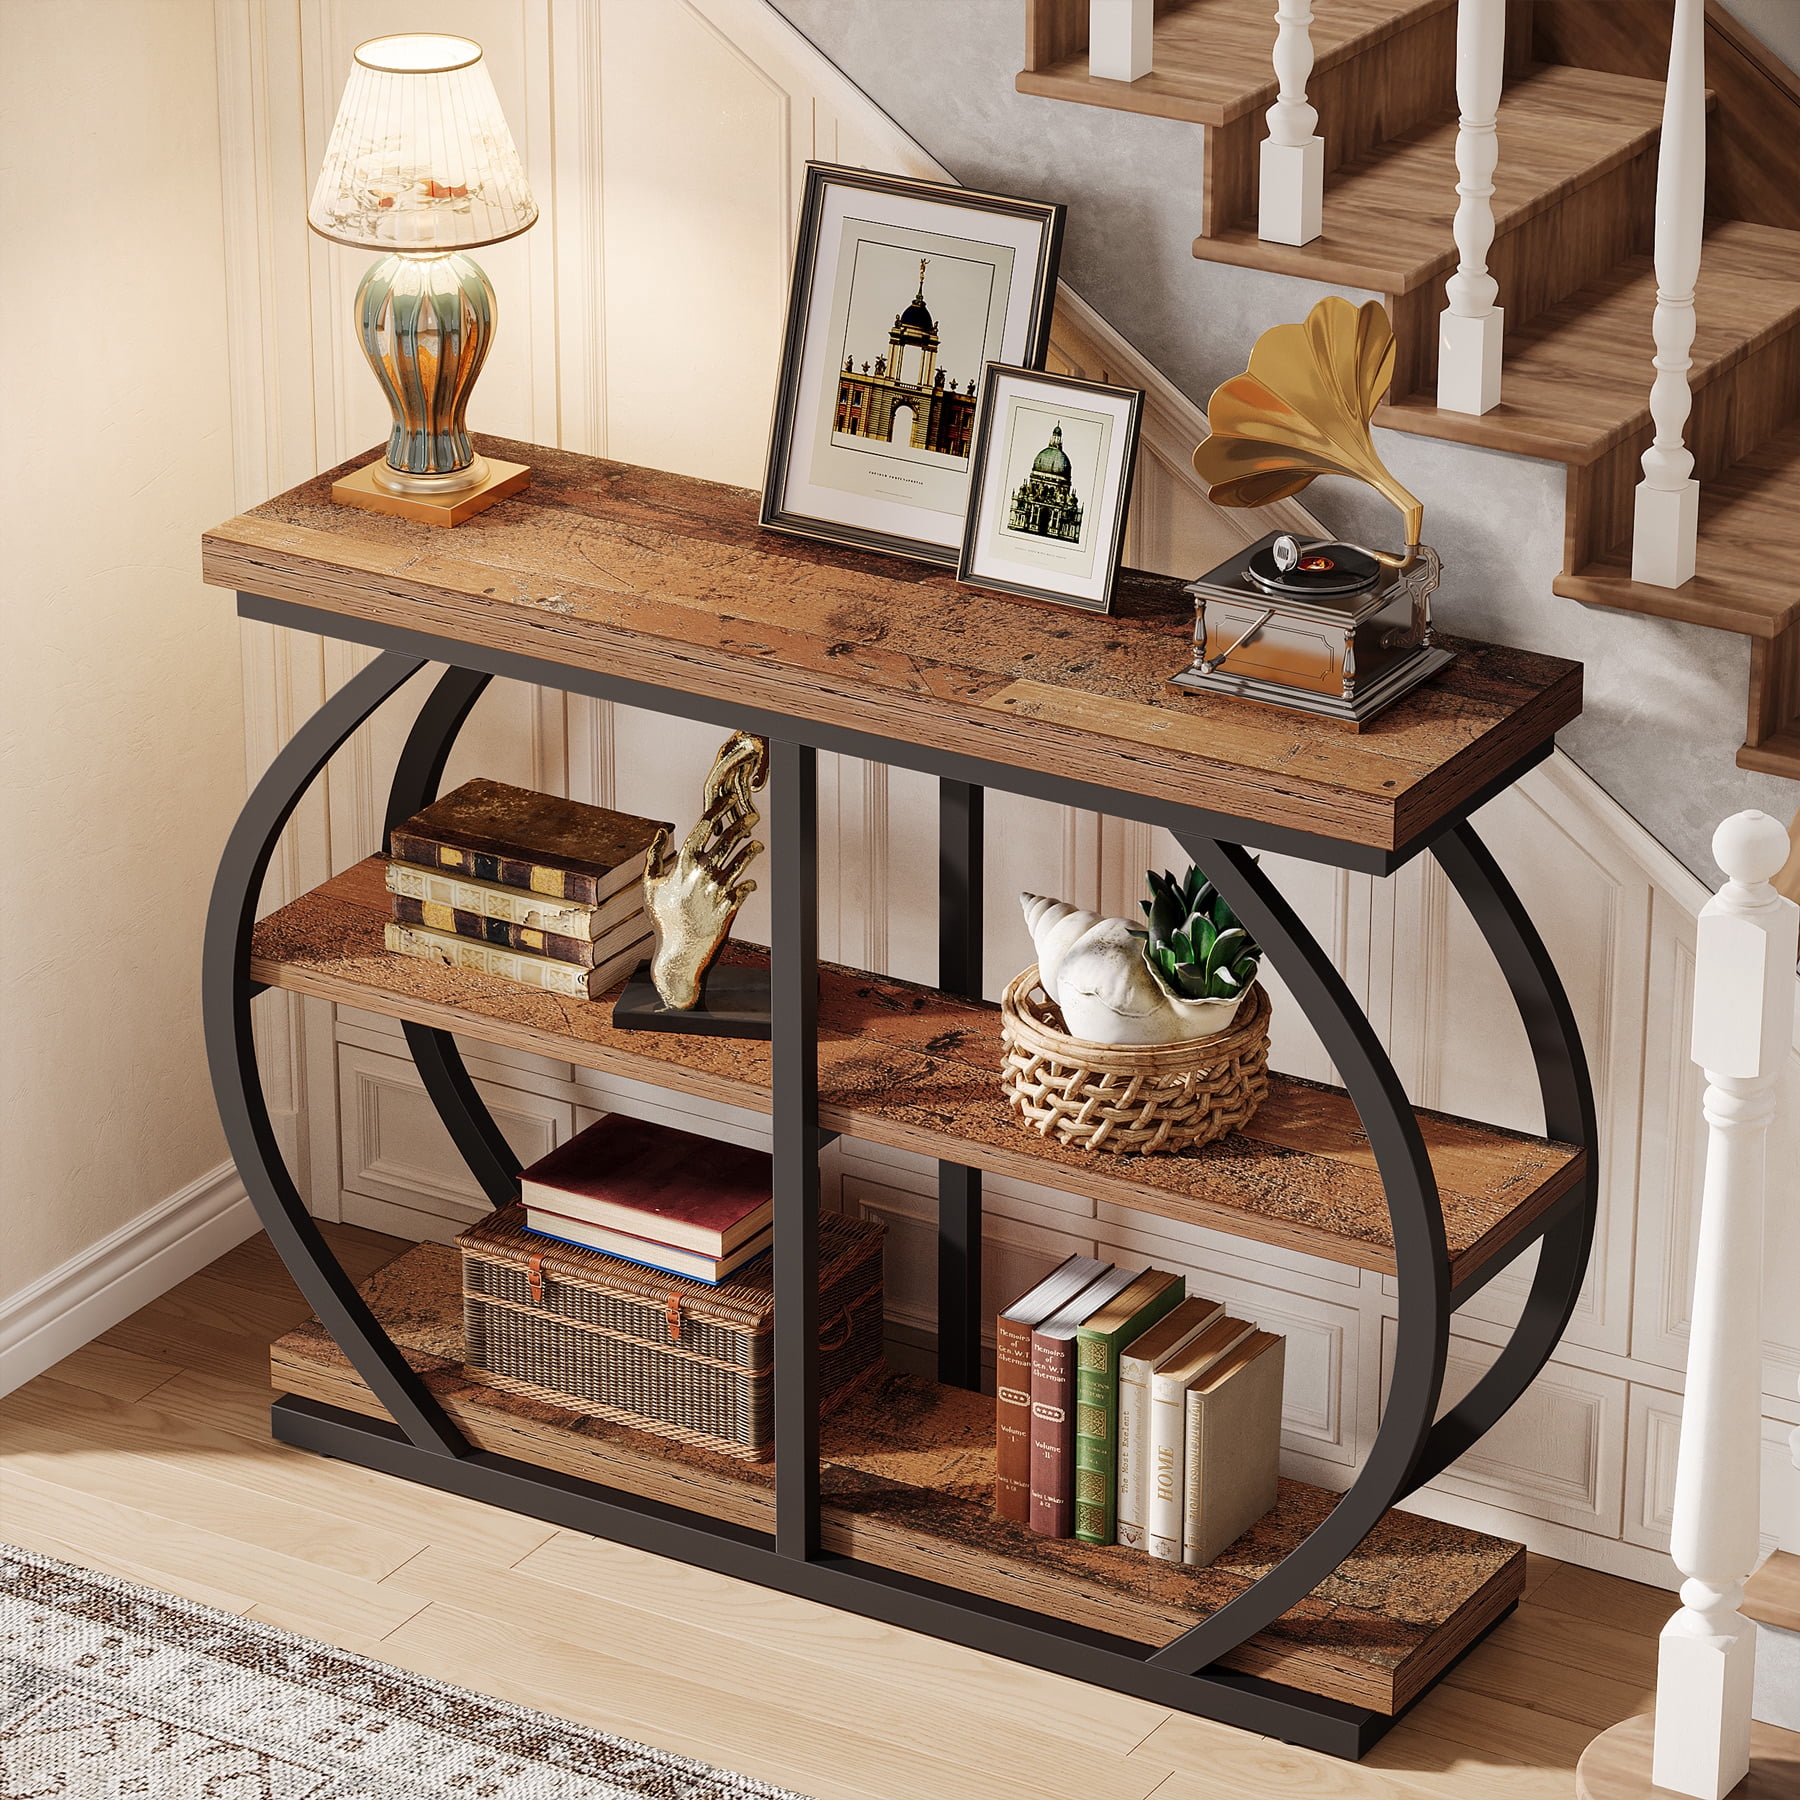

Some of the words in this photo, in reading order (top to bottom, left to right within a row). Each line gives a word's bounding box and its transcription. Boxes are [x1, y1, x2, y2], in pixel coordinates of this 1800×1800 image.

[999, 1327, 1030, 1342] Memoirs
[1010, 1340, 1019, 1348] of
[1034, 1343, 1065, 1358] Memoirs
[998, 1353, 1031, 1367] Sherman
[1045, 1356, 1053, 1364] of
[1033, 1368, 1066, 1383] Sherman
[1191, 1402, 1200, 1427] WITH
[1001, 1424, 1027, 1437] Volume
[1191, 1428, 1200, 1446] THE
[1035, 1440, 1061, 1453] Volume
[1121, 1452, 1129, 1474] Most
[1190, 1447, 1199, 1481] THINGS
[1157, 1445, 1174, 1502] HOME
[1121, 1478, 1129, 1494] The
[1190, 1481, 1199, 1495] WE
[1189, 1496, 1198, 1520] LOVE
